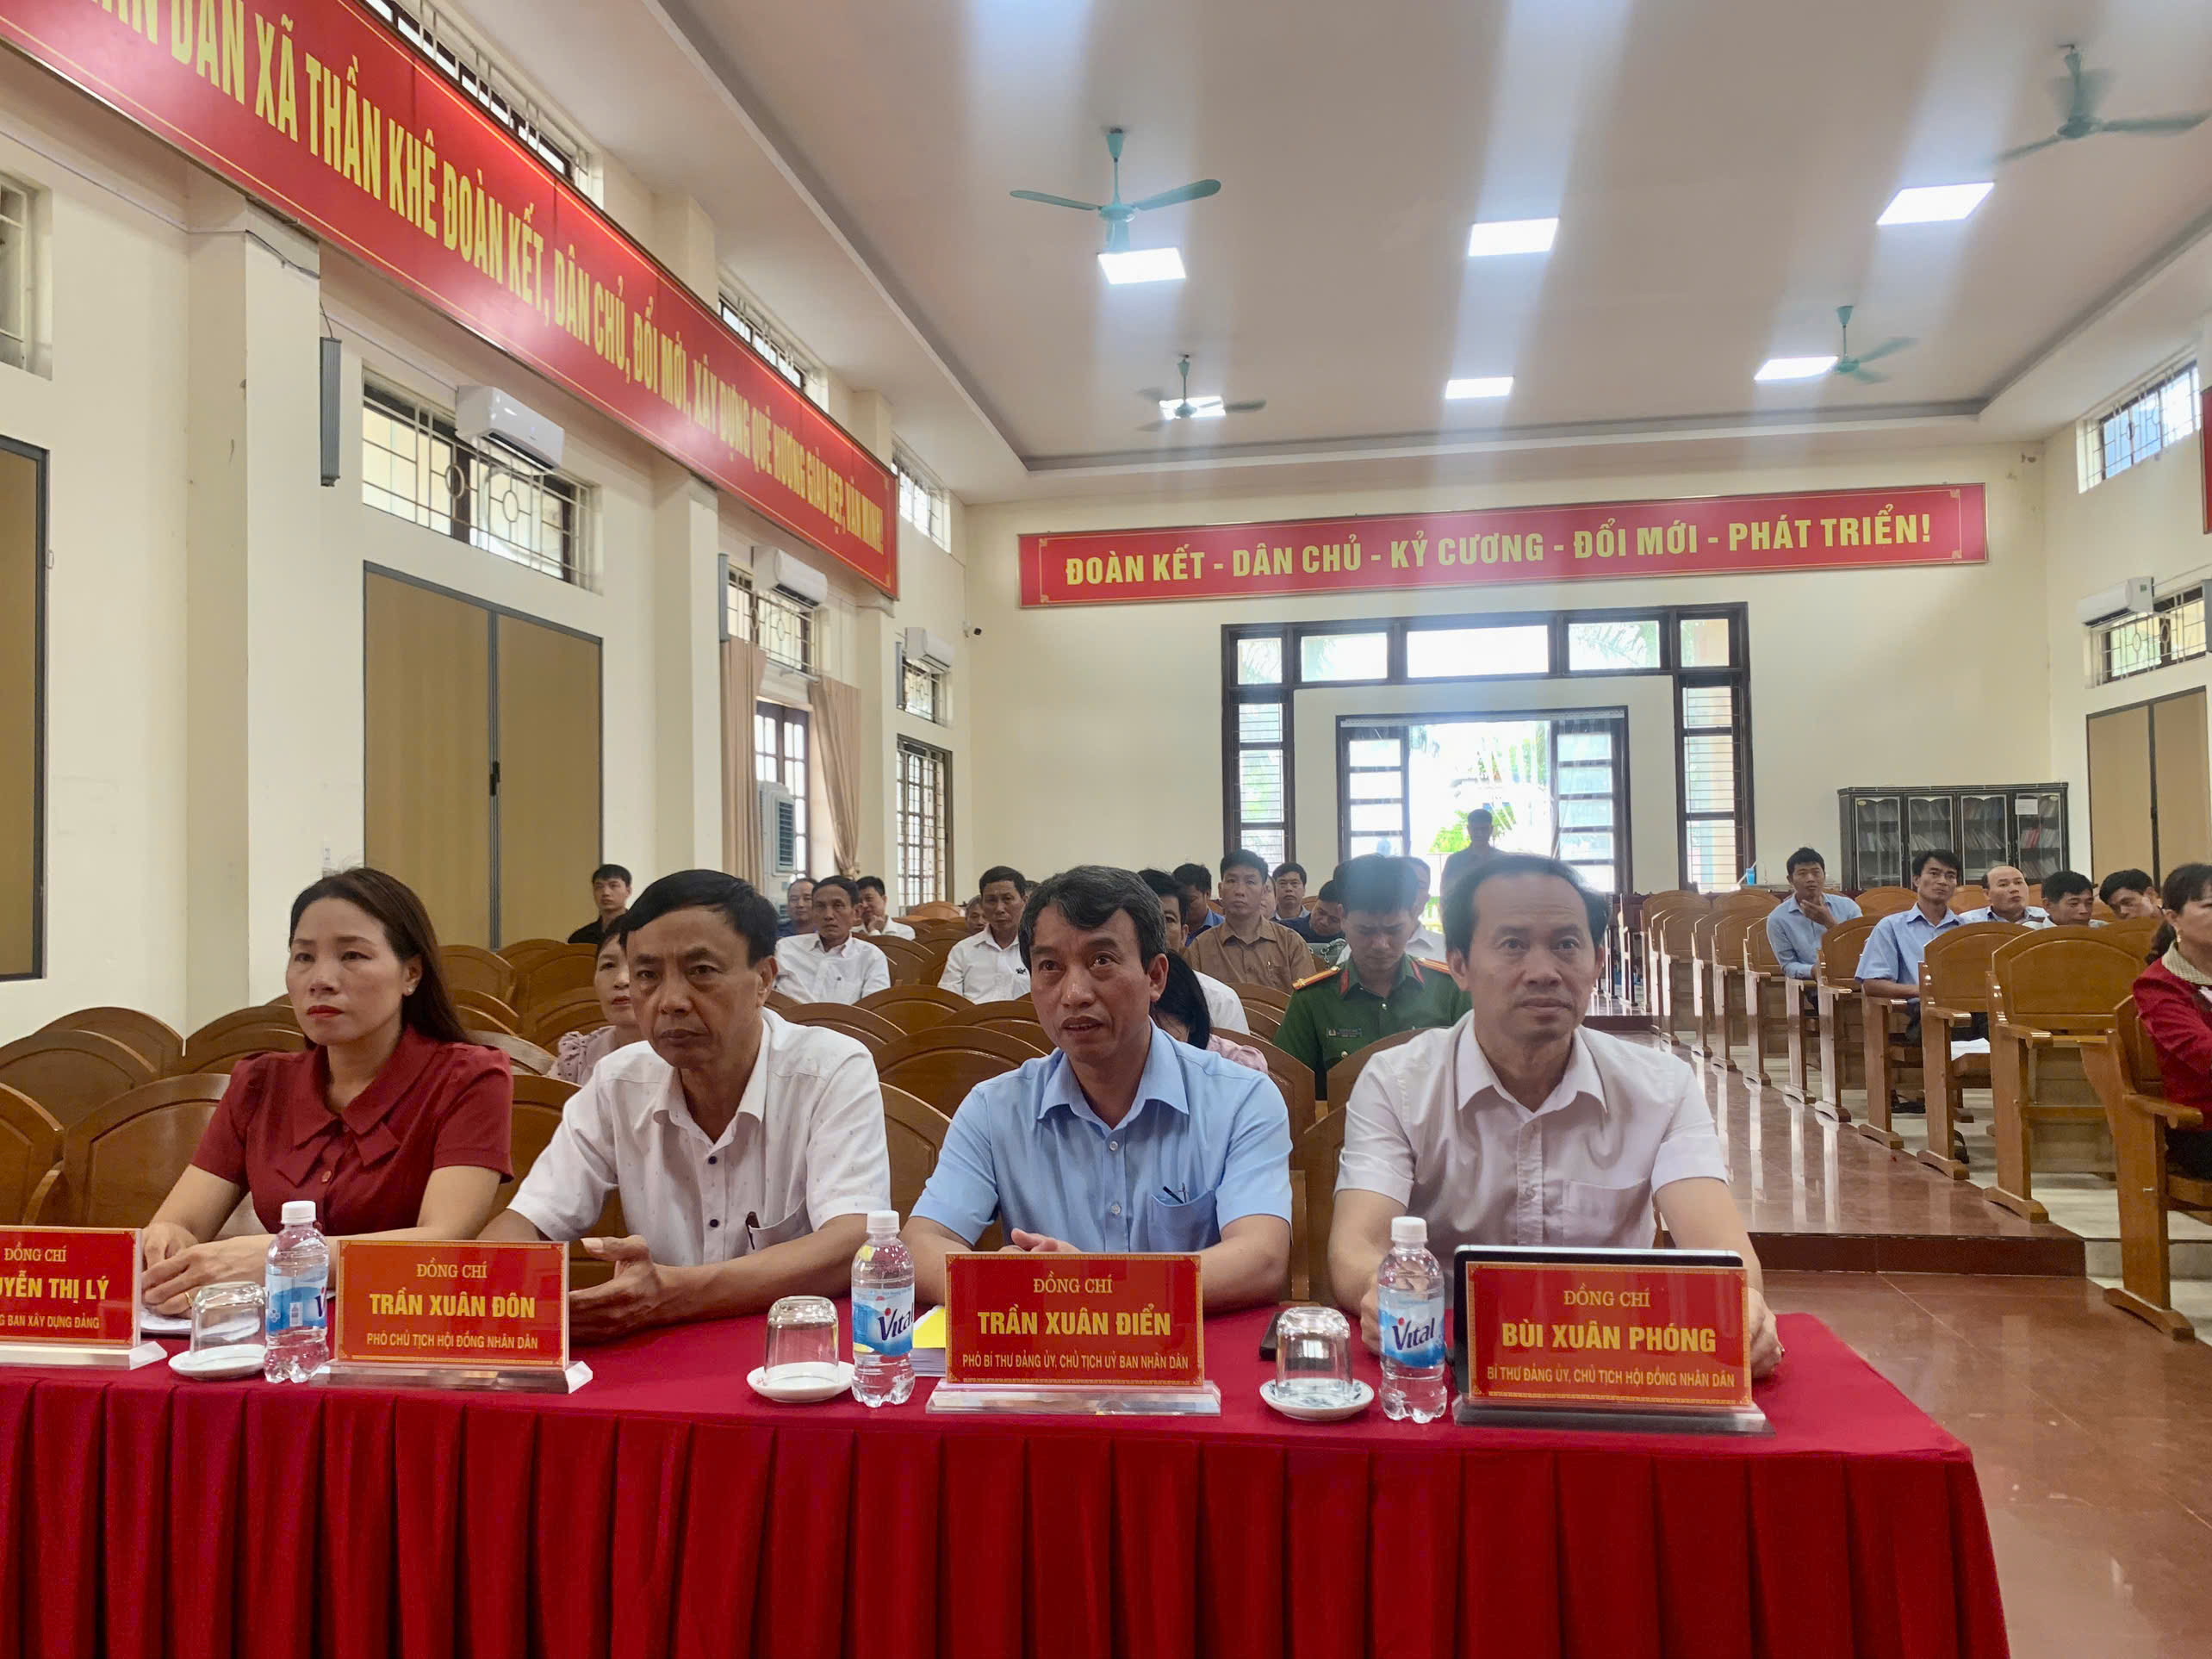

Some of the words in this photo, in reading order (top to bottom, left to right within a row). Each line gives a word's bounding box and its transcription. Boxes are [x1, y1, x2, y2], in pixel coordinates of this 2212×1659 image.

[254, 13, 298, 142] XÃ
[306, 53, 381, 200] THẦN
[388, 117, 437, 239] KHÊ
[443, 160, 503, 284] ĐOÀN
[509, 202, 550, 326] KẾT,
[554, 244, 590, 346] DÂN
[633, 296, 658, 395] ĐỔI
[1066, 551, 1144, 586] ĐOÀN
[1153, 544, 1206, 581] KẾT
[1233, 543, 1293, 577] DÂN
[1302, 534, 1361, 573] CHỦ
[1390, 531, 1428, 569] KỶ
[1438, 533, 1544, 566] CƯƠNG
[1574, 518, 1626, 559] ĐỔI
[1637, 520, 1698, 556] MỚI
[1729, 514, 1812, 551] PHÁT
[1820, 504, 1931, 547] TRIỂN!
[4, 1241, 41, 1261] ĐỒNG
[45, 1245, 67, 1262] CHÍ
[416, 1257, 458, 1278] ĐỒNG
[462, 1261, 488, 1278] CHÍ
[0, 1271, 42, 1298] YỄN
[48, 1278, 80, 1304] THỊ
[85, 1276, 109, 1301] LÝ
[1034, 1271, 1080, 1293] ĐỒNG
[1084, 1274, 1113, 1293] CHÍ
[1563, 1283, 1615, 1307] ĐỒNG
[1619, 1288, 1650, 1307] CHÍ
[370, 1286, 423, 1315] TRẦN
[429, 1291, 486, 1317] XUÂN
[492, 1292, 535, 1318] ĐÔN
[8, 1314, 26, 1327] BAN
[877, 1302, 914, 1341] Vital
[978, 1303, 1038, 1335] TRẦN
[1045, 1308, 1109, 1335] XUÂN
[1115, 1303, 1171, 1336] ĐIỂN
[389, 1329, 410, 1345] CHỦ
[413, 1334, 434, 1349] TỊCH
[438, 1332, 454, 1350] HỘI
[488, 1333, 515, 1349] NHÂN
[518, 1333, 538, 1349] DÂN
[1392, 1317, 1435, 1351] Vital
[1502, 1319, 1544, 1347] BÙI
[1551, 1320, 1620, 1350] XUÂN
[962, 1351, 982, 1368] PHÓ
[984, 1351, 992, 1368] BÍ
[995, 1352, 1014, 1368] THƯ
[1016, 1349, 1041, 1368] ĐẢNG
[1059, 1350, 1079, 1369] CHỦ
[1081, 1354, 1102, 1370] TỊCH
[1120, 1355, 1139, 1369] BAN
[1141, 1352, 1166, 1369] NHÂN
[1169, 1353, 1189, 1370] DÂN
[1488, 1364, 1498, 1379] BÍ
[1500, 1365, 1521, 1381] THƯ
[1523, 1363, 1552, 1382] ĐẢNG
[1574, 1364, 1596, 1383] CHỦ
[1598, 1370, 1623, 1386] TỊCH
[1625, 1368, 1643, 1388] HỘI
[1680, 1369, 1709, 1387] NHÂN
[1712, 1370, 1735, 1388] DÂN
